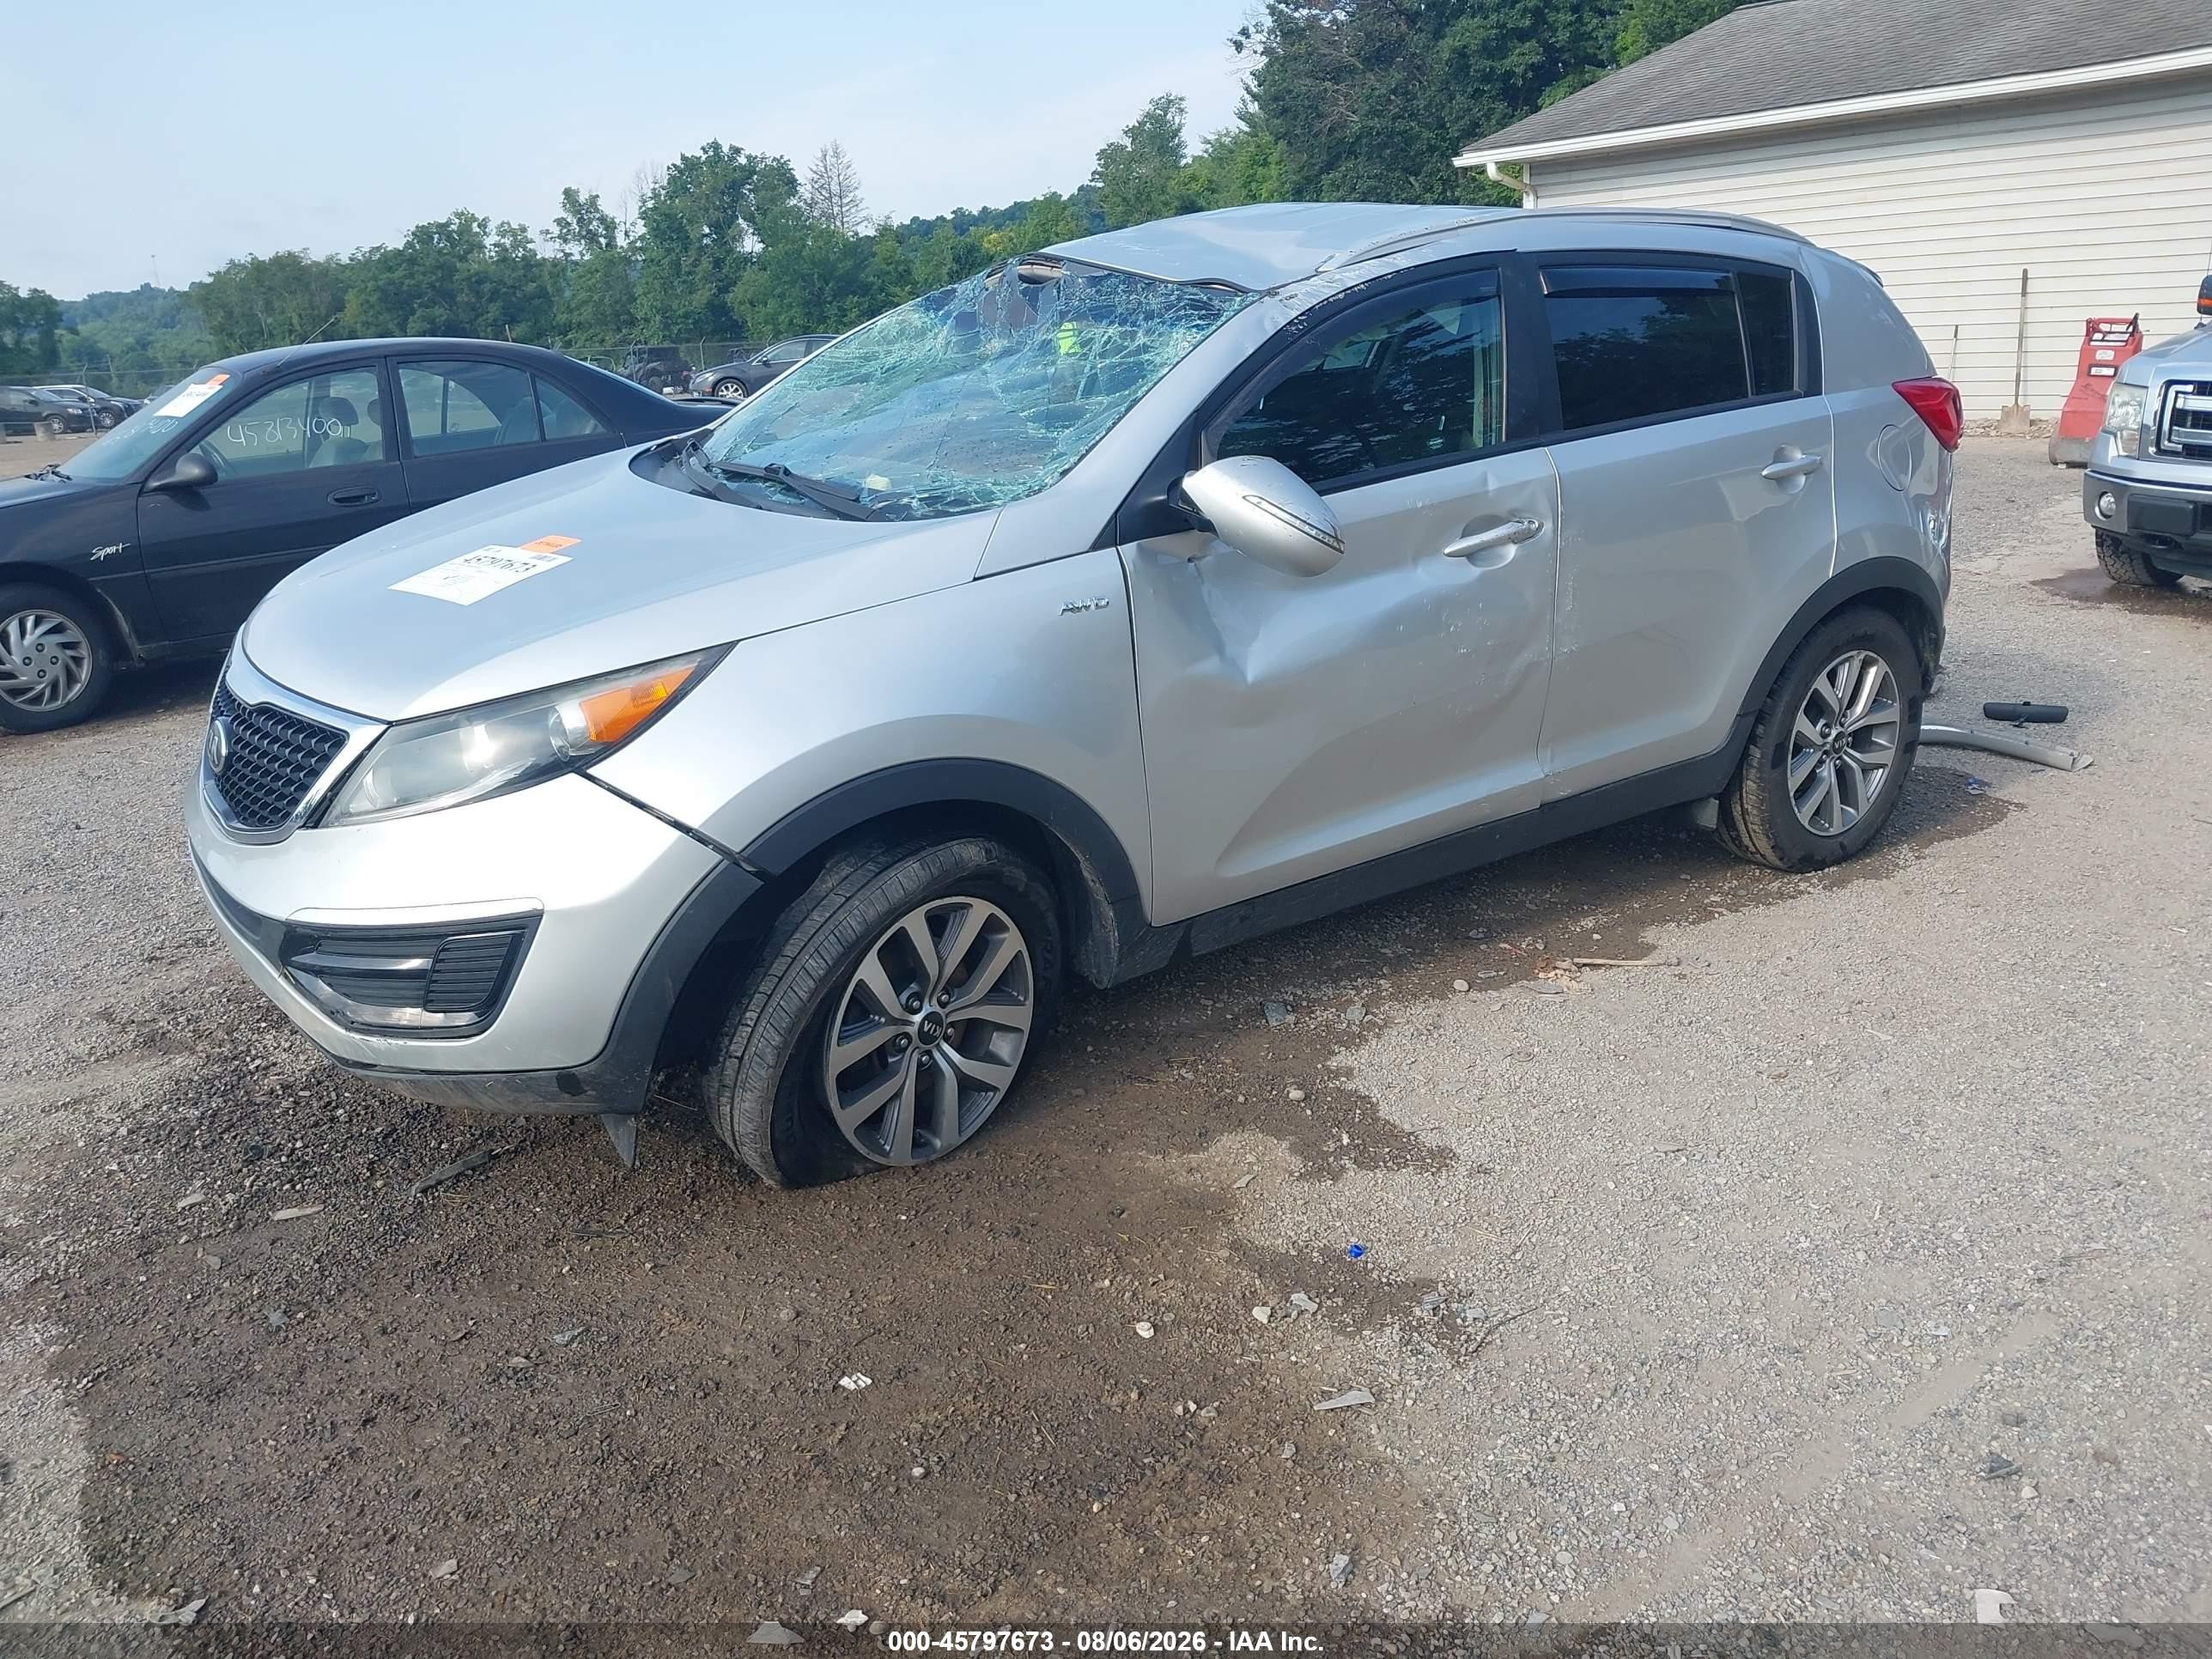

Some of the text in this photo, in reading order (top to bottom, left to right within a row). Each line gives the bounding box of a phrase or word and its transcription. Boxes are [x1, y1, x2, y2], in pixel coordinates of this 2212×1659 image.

[90, 542, 131, 562] Sport
[1058, 597, 1109, 616] AWD
[923, 1019, 943, 1037] KIA
